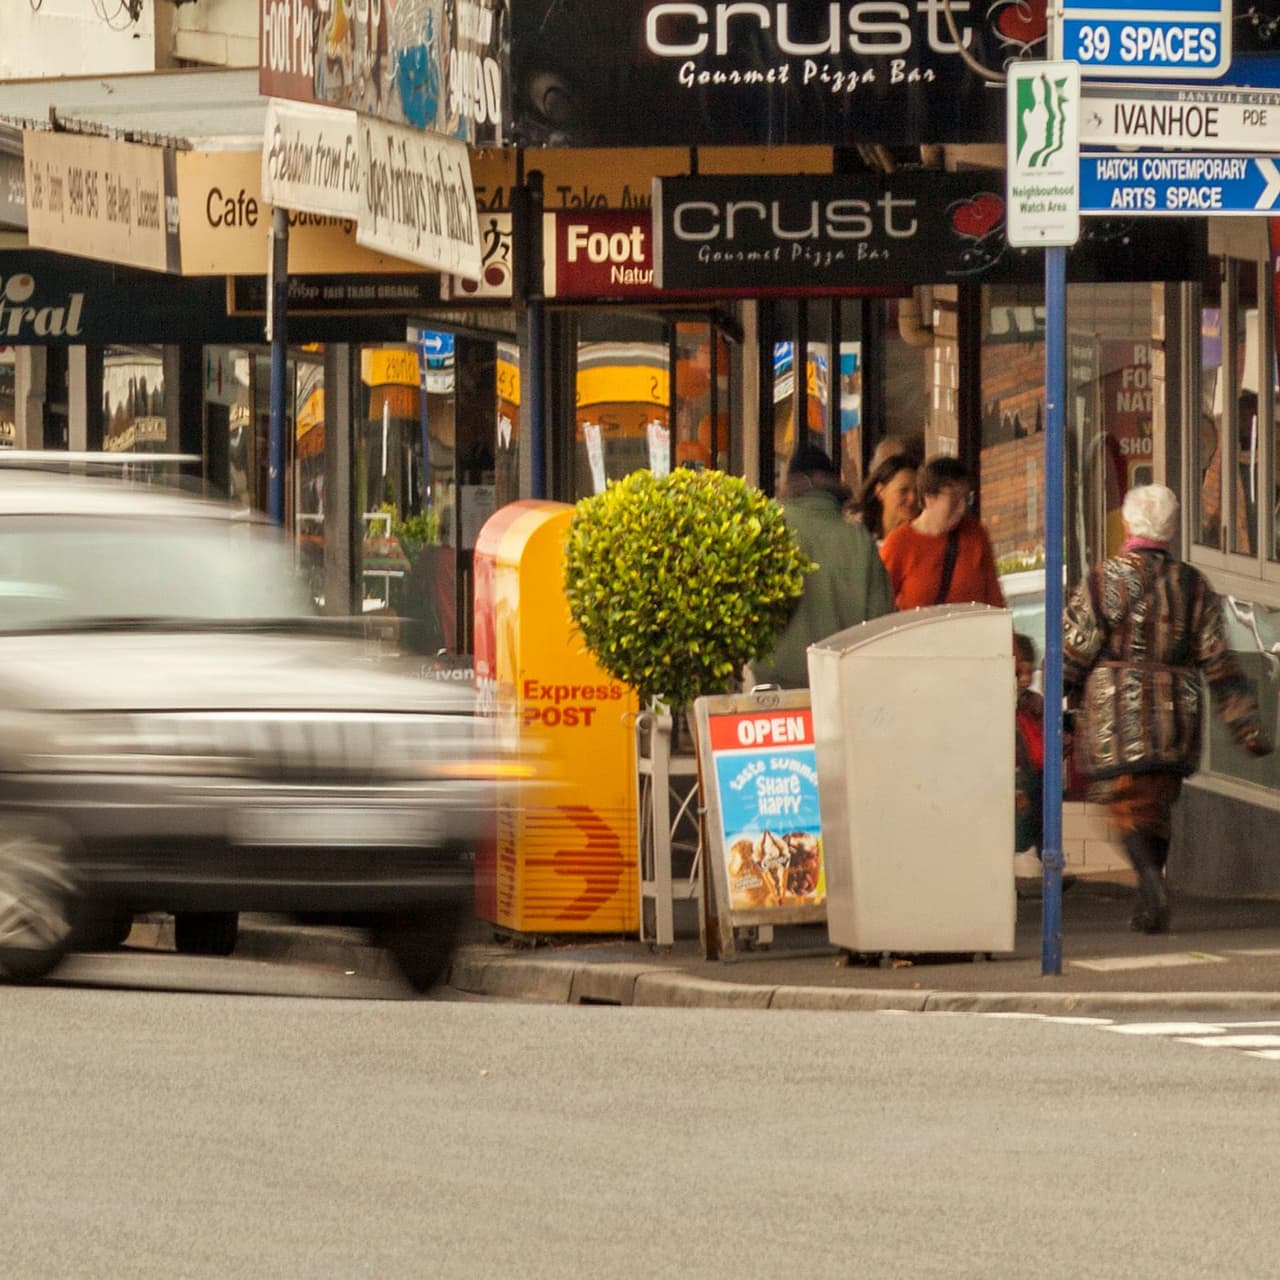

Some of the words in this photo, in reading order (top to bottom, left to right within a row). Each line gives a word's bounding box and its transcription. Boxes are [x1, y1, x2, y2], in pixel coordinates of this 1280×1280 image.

[1078, 27, 1111, 62] 39
[1120, 26, 1217, 63] SPACES
[679, 60, 789, 87] Gourmet
[802, 60, 876, 92] Pizza
[890, 59, 937, 86] Bar
[1113, 103, 1220, 138] IVANHOE
[1243, 109, 1268, 127] PDE
[1096, 158, 1139, 181] HATCH
[1142, 158, 1248, 182] CONTEMPORARY
[1012, 184, 1075, 199] Neighbourhood
[1110, 187, 1156, 209] ARTS
[1165, 186, 1223, 209] SPACE
[205, 187, 259, 228] Cafe
[673, 191, 919, 242] crust
[1019, 201, 1045, 214] Watch
[1047, 201, 1067, 213] Area
[566, 223, 646, 264] Foot
[697, 243, 781, 265] Gourmet
[790, 243, 845, 268] Pizza
[856, 243, 891, 261] Bar
[610, 265, 655, 286] Natur
[435, 666, 475, 682] ivan
[523, 679, 623, 703] Express
[523, 706, 597, 729] POST
[737, 716, 806, 746] OPEN
[728, 760, 767, 791] taste
